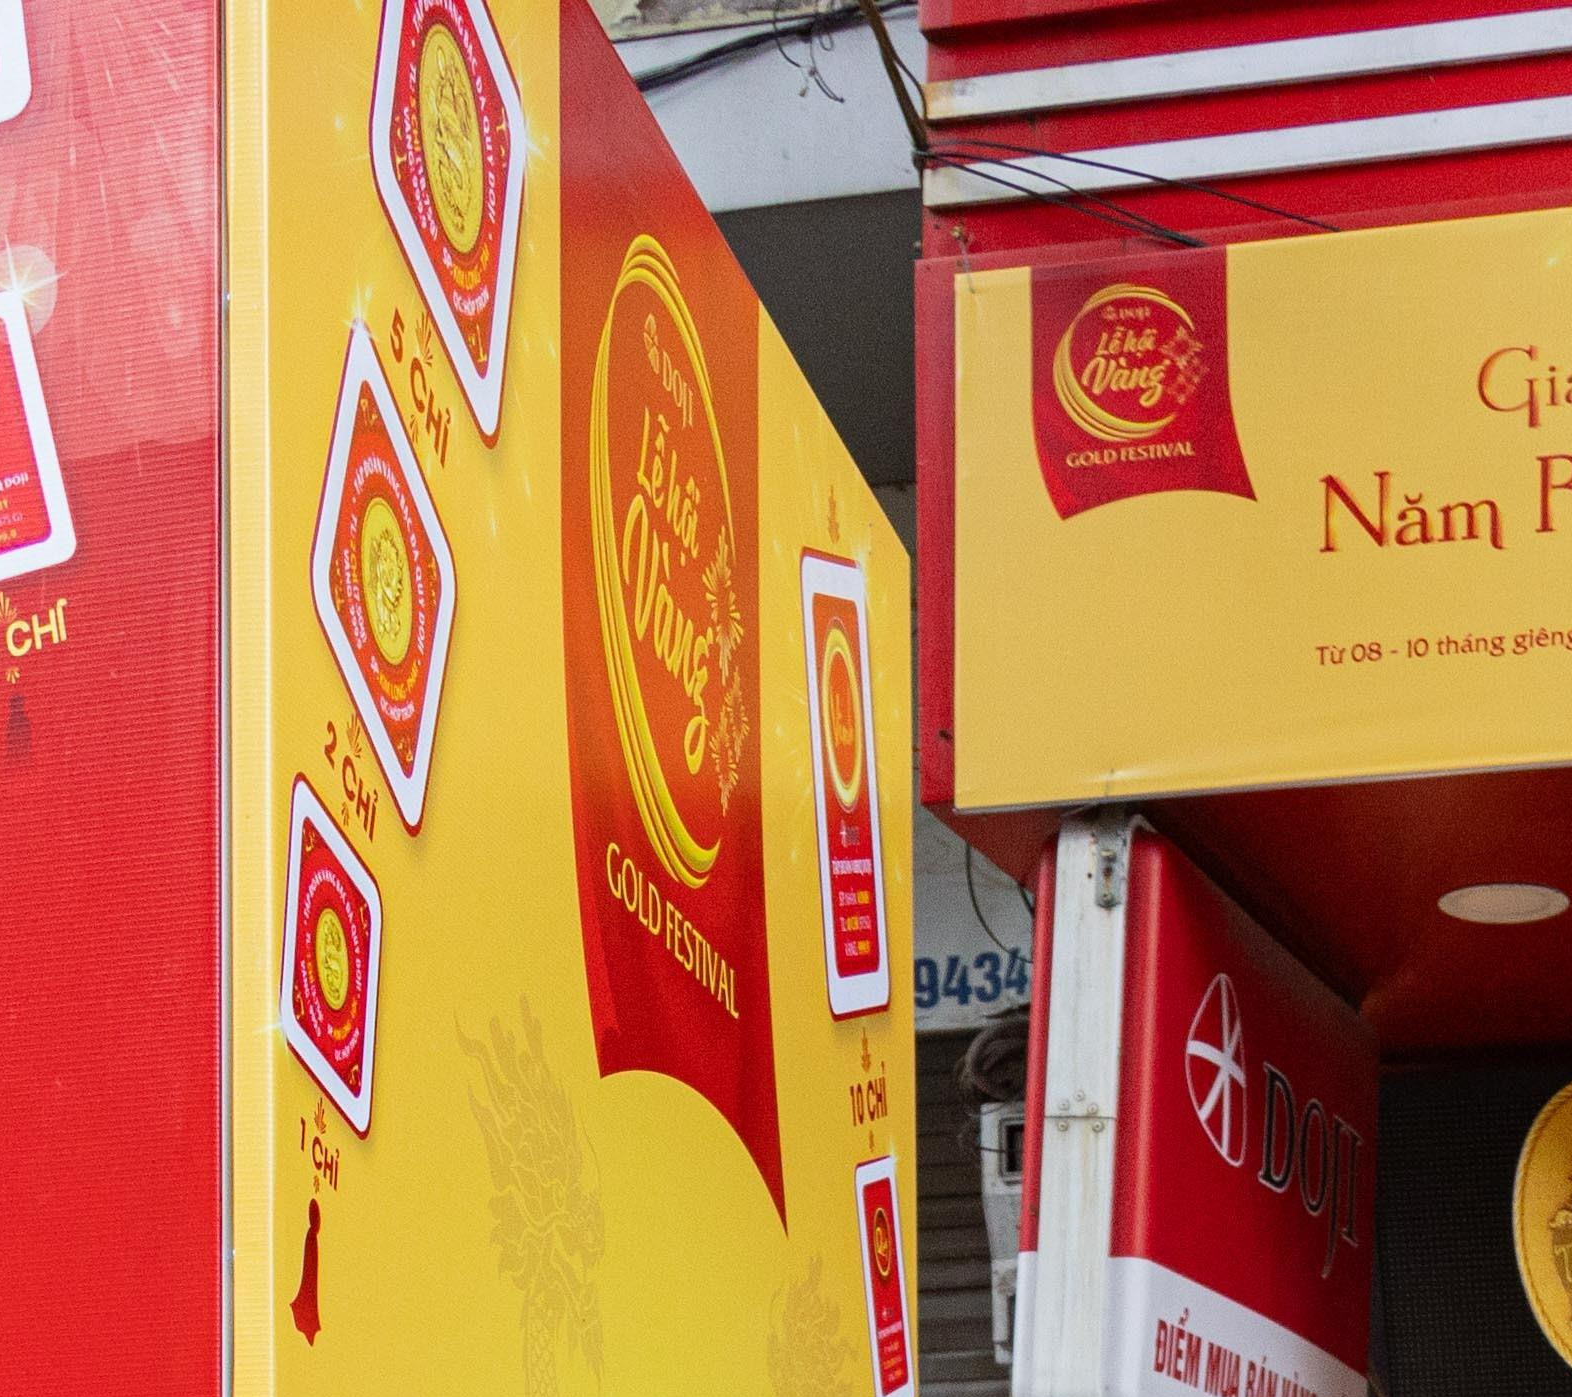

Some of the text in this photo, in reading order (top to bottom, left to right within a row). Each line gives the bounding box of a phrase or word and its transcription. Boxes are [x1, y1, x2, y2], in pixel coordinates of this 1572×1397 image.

[388, 305, 452, 470] 5 CHỈ
[1081, 355, 1172, 408] Vàng
[636, 405, 700, 568] Lễ hội
[1065, 440, 1196, 469] GOLD FESTIVAL
[1317, 470, 1506, 554] Năm
[4, 598, 69, 659] CHỈ
[622, 492, 716, 776] Vàng
[1316, 643, 1346, 667] Từ
[1350, 641, 1384, 665] 08
[1407, 637, 1429, 660] 10
[1436, 627, 1506, 659] tháng
[323, 719, 380, 844] 2 CHỈ
[605, 841, 740, 1020] GOLD FESTIVAL
[914, 946, 1029, 1009] 9434
[849, 1067, 888, 1129] 10 CHỈ
[299, 1115, 340, 1192] 1 CHỈ
[1257, 1061, 1364, 1280] DOJI
[1153, 1307, 1202, 1389] ĐIỂM
